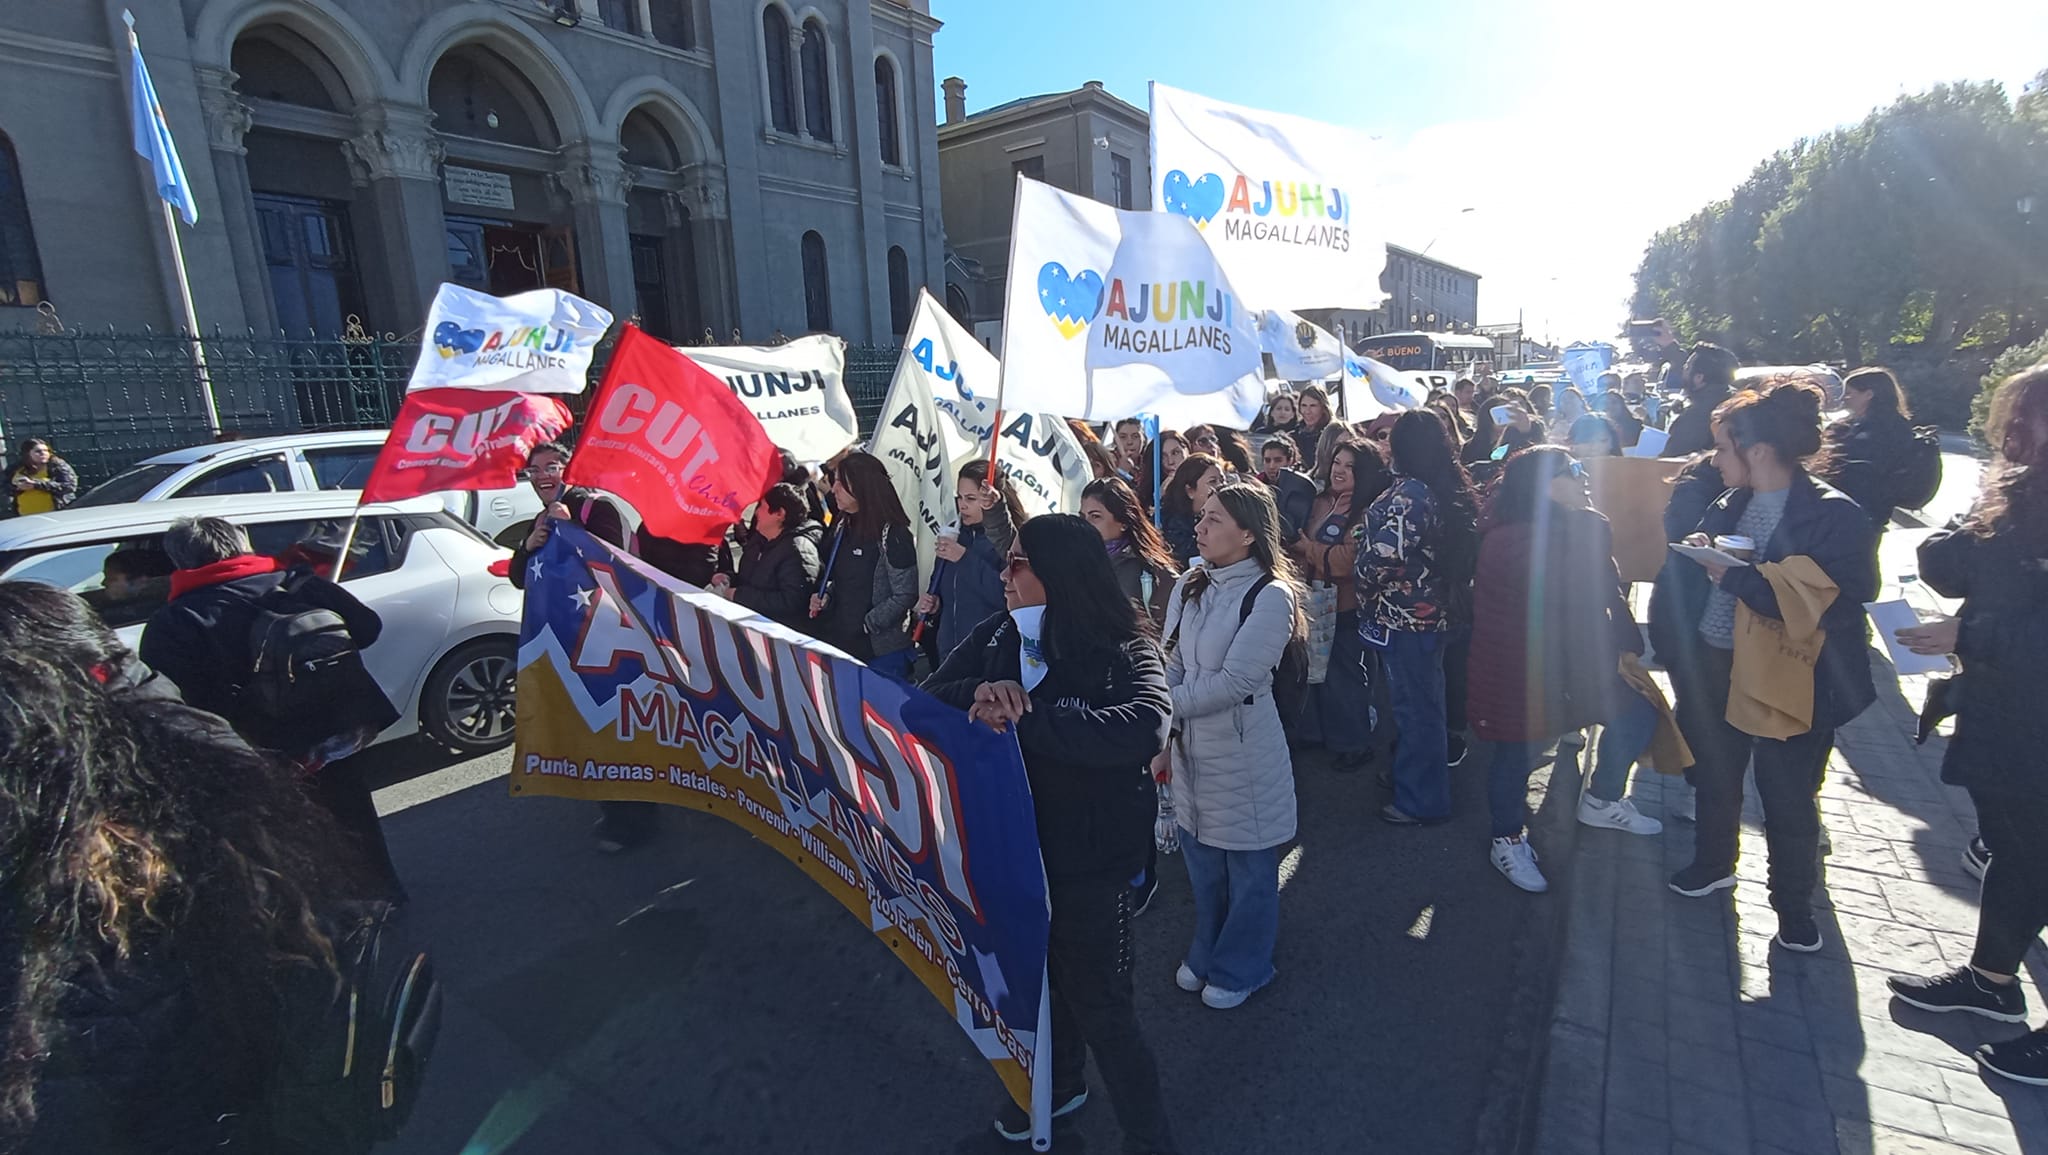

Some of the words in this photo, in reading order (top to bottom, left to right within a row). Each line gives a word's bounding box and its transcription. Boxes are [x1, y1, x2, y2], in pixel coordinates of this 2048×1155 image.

[1226, 174, 1350, 225] AJUNJI
[1224, 218, 1350, 253] MAGALLANES
[1105, 278, 1232, 328] AJUNJI
[482, 325, 577, 353] AJUNJI
[1103, 323, 1232, 356] MAGALLANES
[1387, 345, 1421, 357] BUENO
[726, 368, 826, 398] JUNJI
[405, 396, 528, 455] CUT
[600, 382, 720, 485] CUT
[757, 405, 821, 420] LLANES
[586, 436, 627, 452] Central
[571, 561, 986, 925] AJUNJI
[616, 684, 967, 957] MAGALLANES
[525, 755, 578, 778] Punta
[582, 760, 654, 782] Arenas
[669, 767, 728, 800] Natales
[737, 788, 792, 836] Porvenir
[800, 826, 857, 889] Williams
[896, 910, 935, 963] Edén
[944, 955, 992, 1022] Cerro
